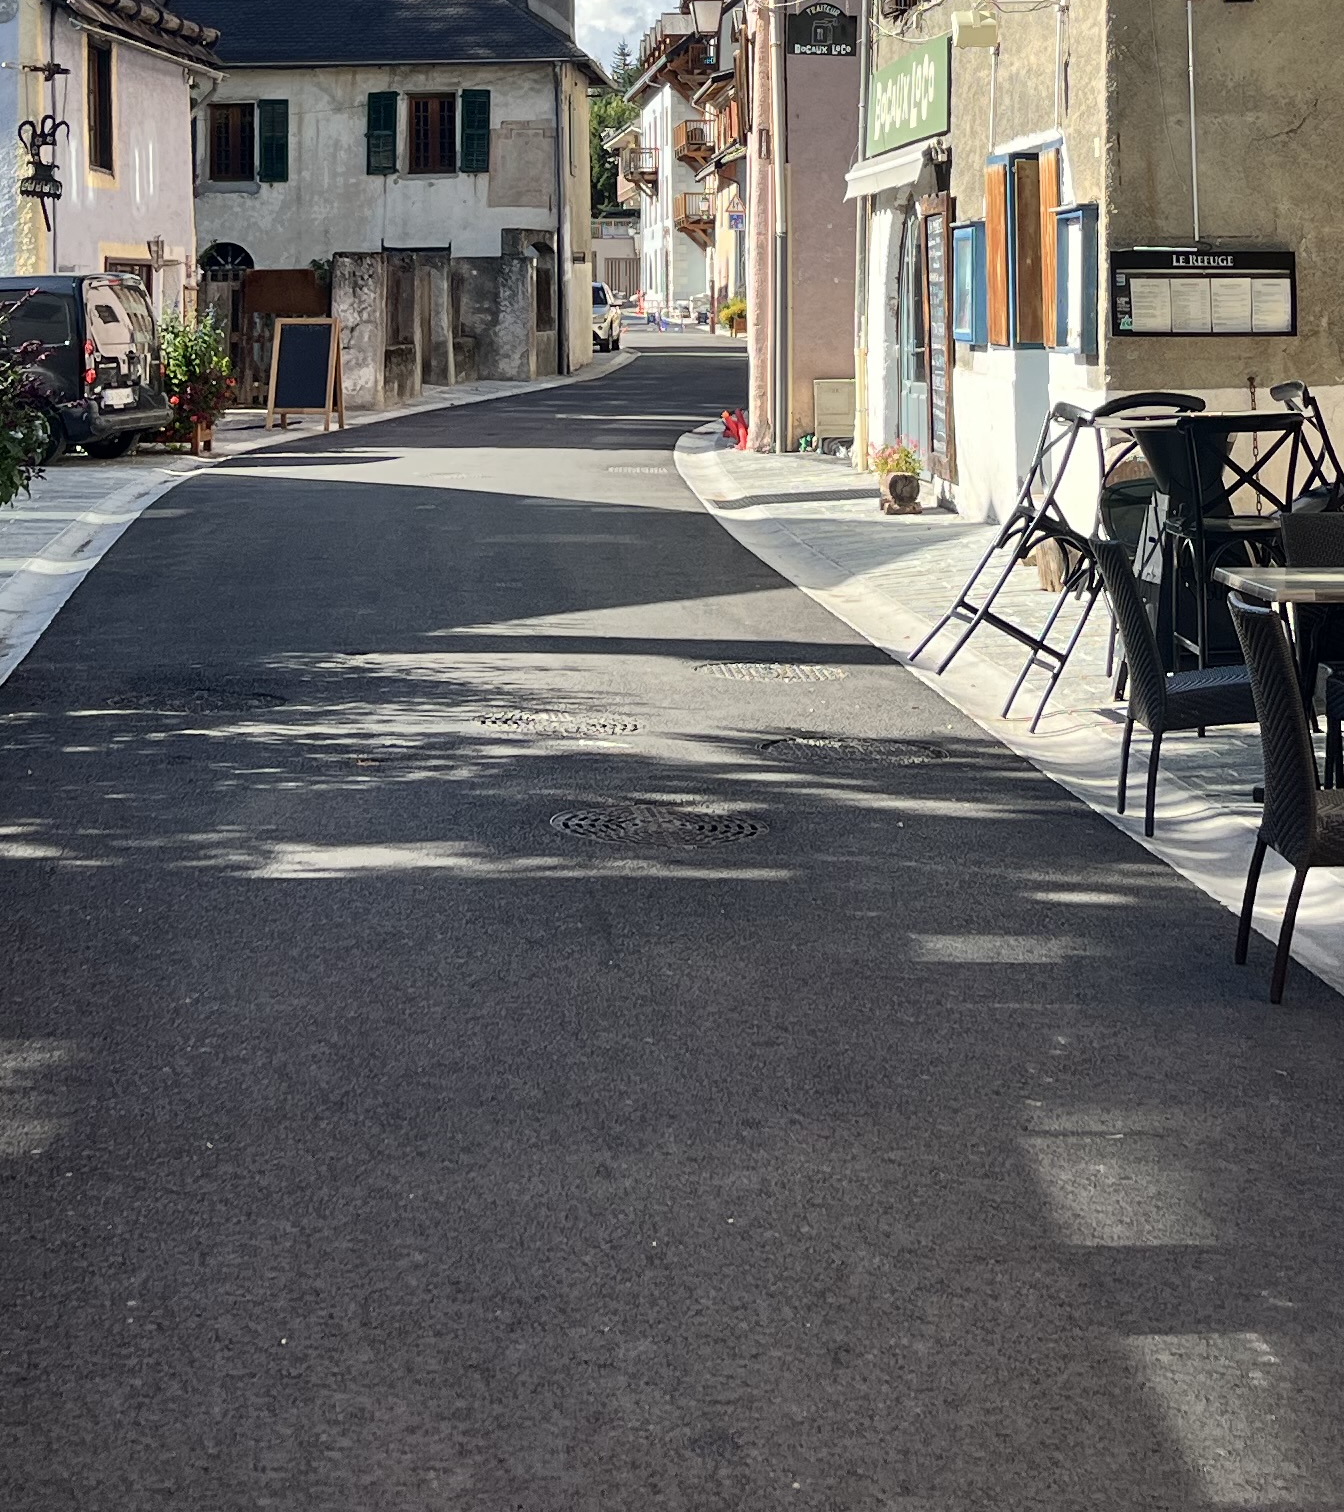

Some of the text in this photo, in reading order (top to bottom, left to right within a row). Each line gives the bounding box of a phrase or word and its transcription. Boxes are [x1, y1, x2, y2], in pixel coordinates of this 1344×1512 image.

[806, 4, 841, 17] TRAITEUR
[1172, 254, 1234, 266] LE REFUGE
